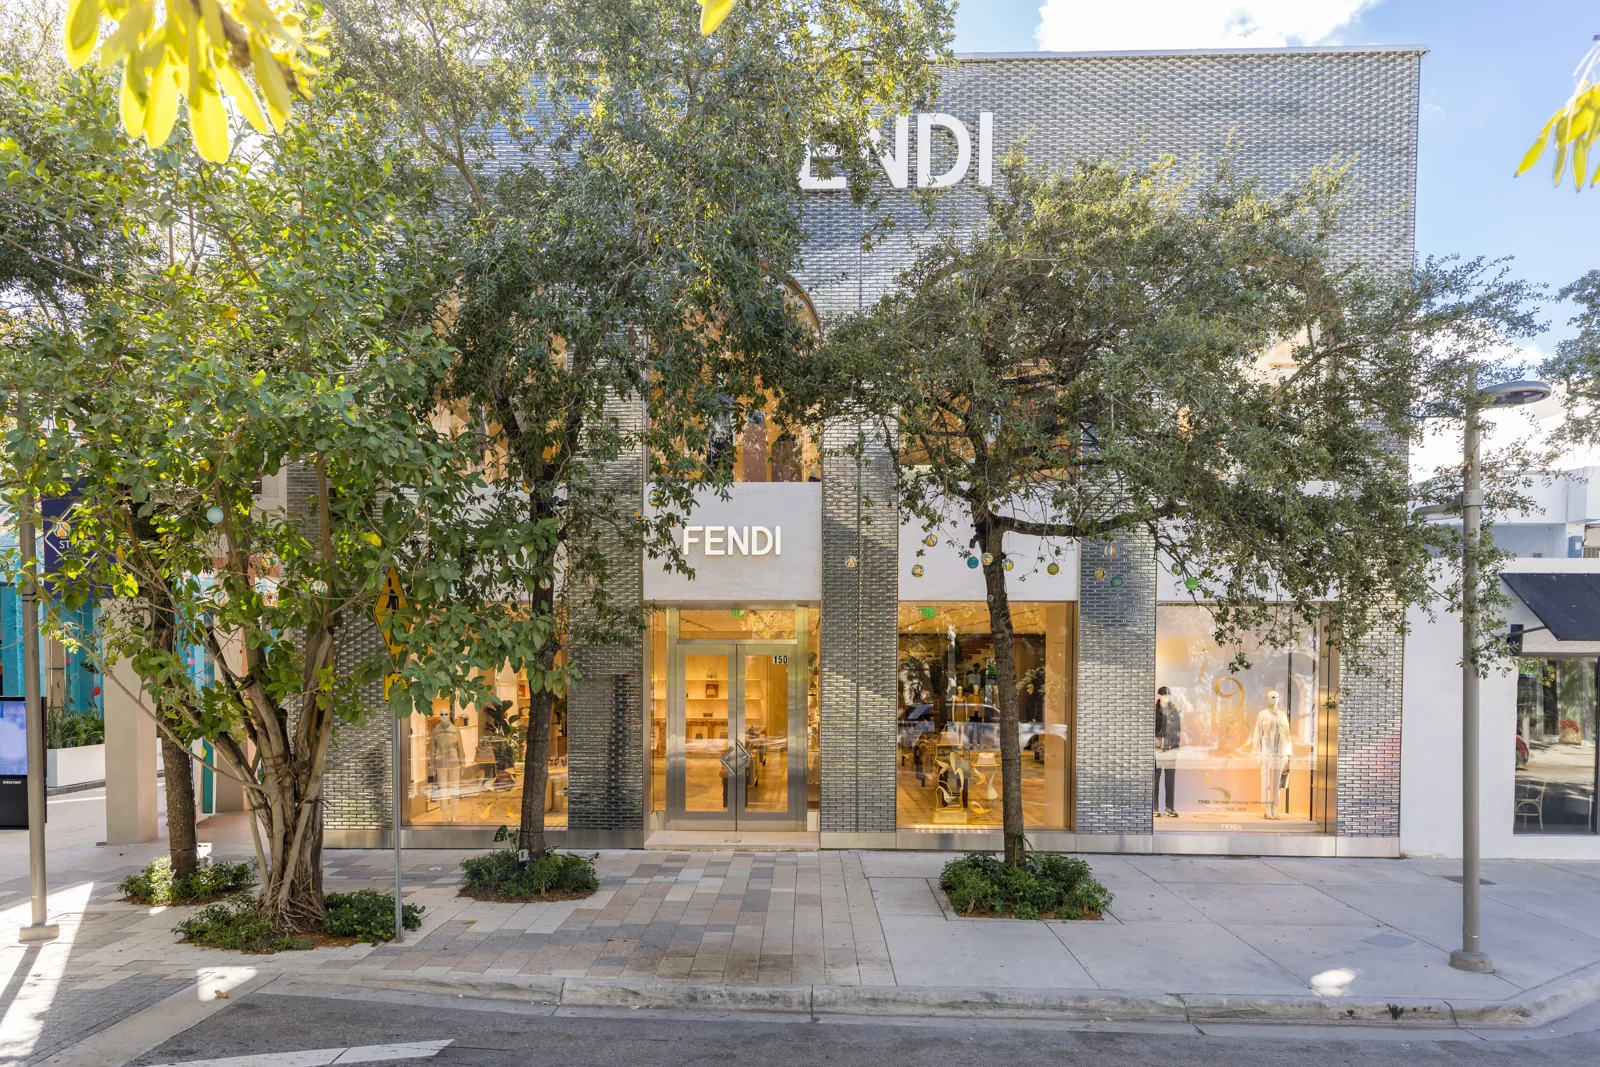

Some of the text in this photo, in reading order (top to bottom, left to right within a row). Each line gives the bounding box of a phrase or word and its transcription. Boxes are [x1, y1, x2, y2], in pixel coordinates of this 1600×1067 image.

[799, 112, 993, 189] ENDI
[683, 525, 781, 556] FENDI
[773, 655, 788, 664] 150
